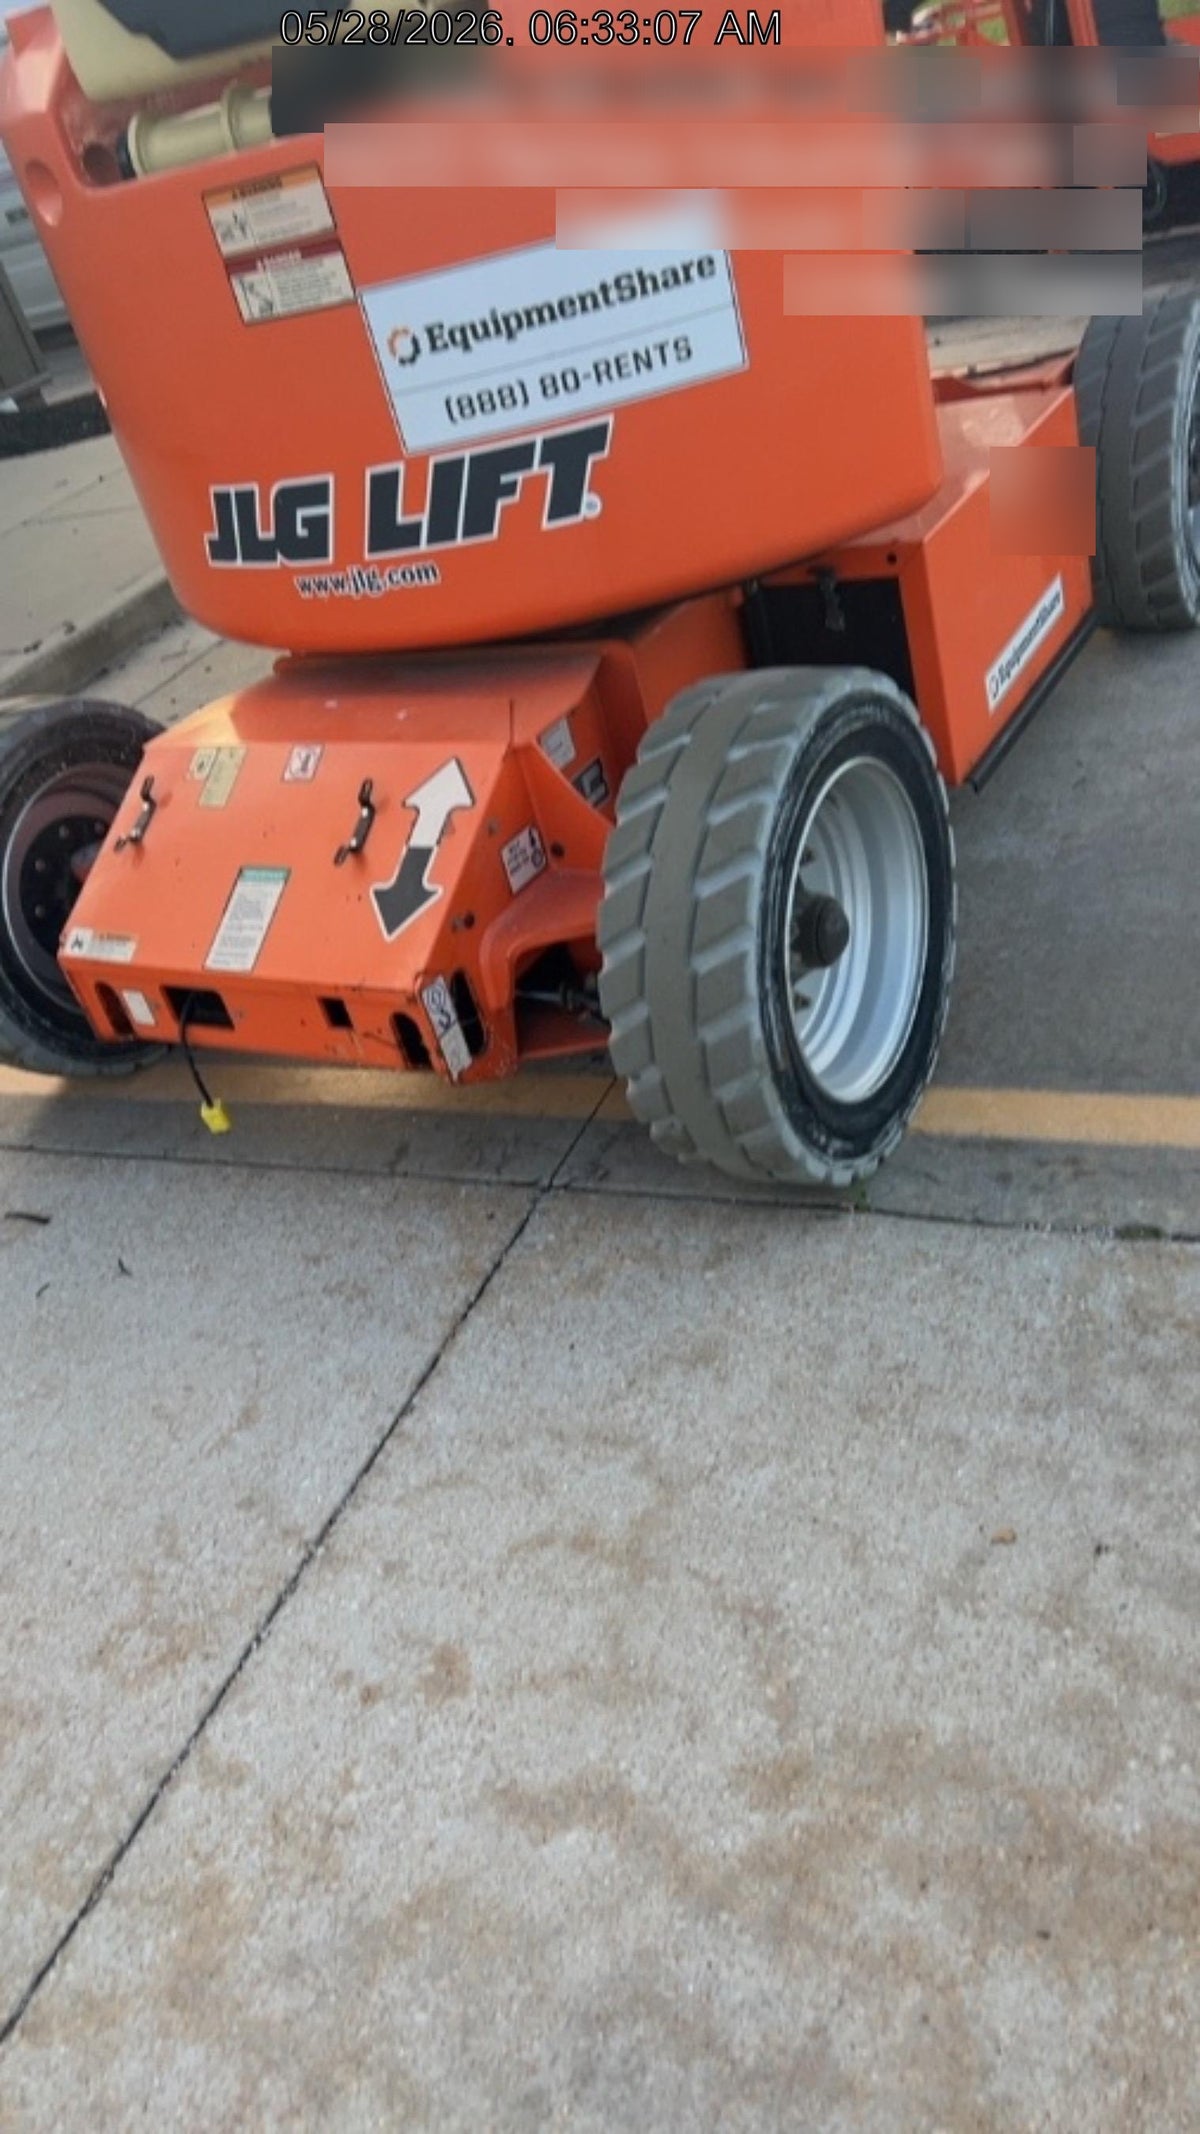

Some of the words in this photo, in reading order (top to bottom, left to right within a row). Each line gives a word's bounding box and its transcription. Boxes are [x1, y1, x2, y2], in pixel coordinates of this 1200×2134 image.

[424, 253, 717, 355] EquipmentShare
[445, 379, 530, 424] (888)
[540, 335, 692, 400] 80-RENTS
[204, 473, 334, 568] JLG
[294, 560, 441, 599] www.jlg.com
